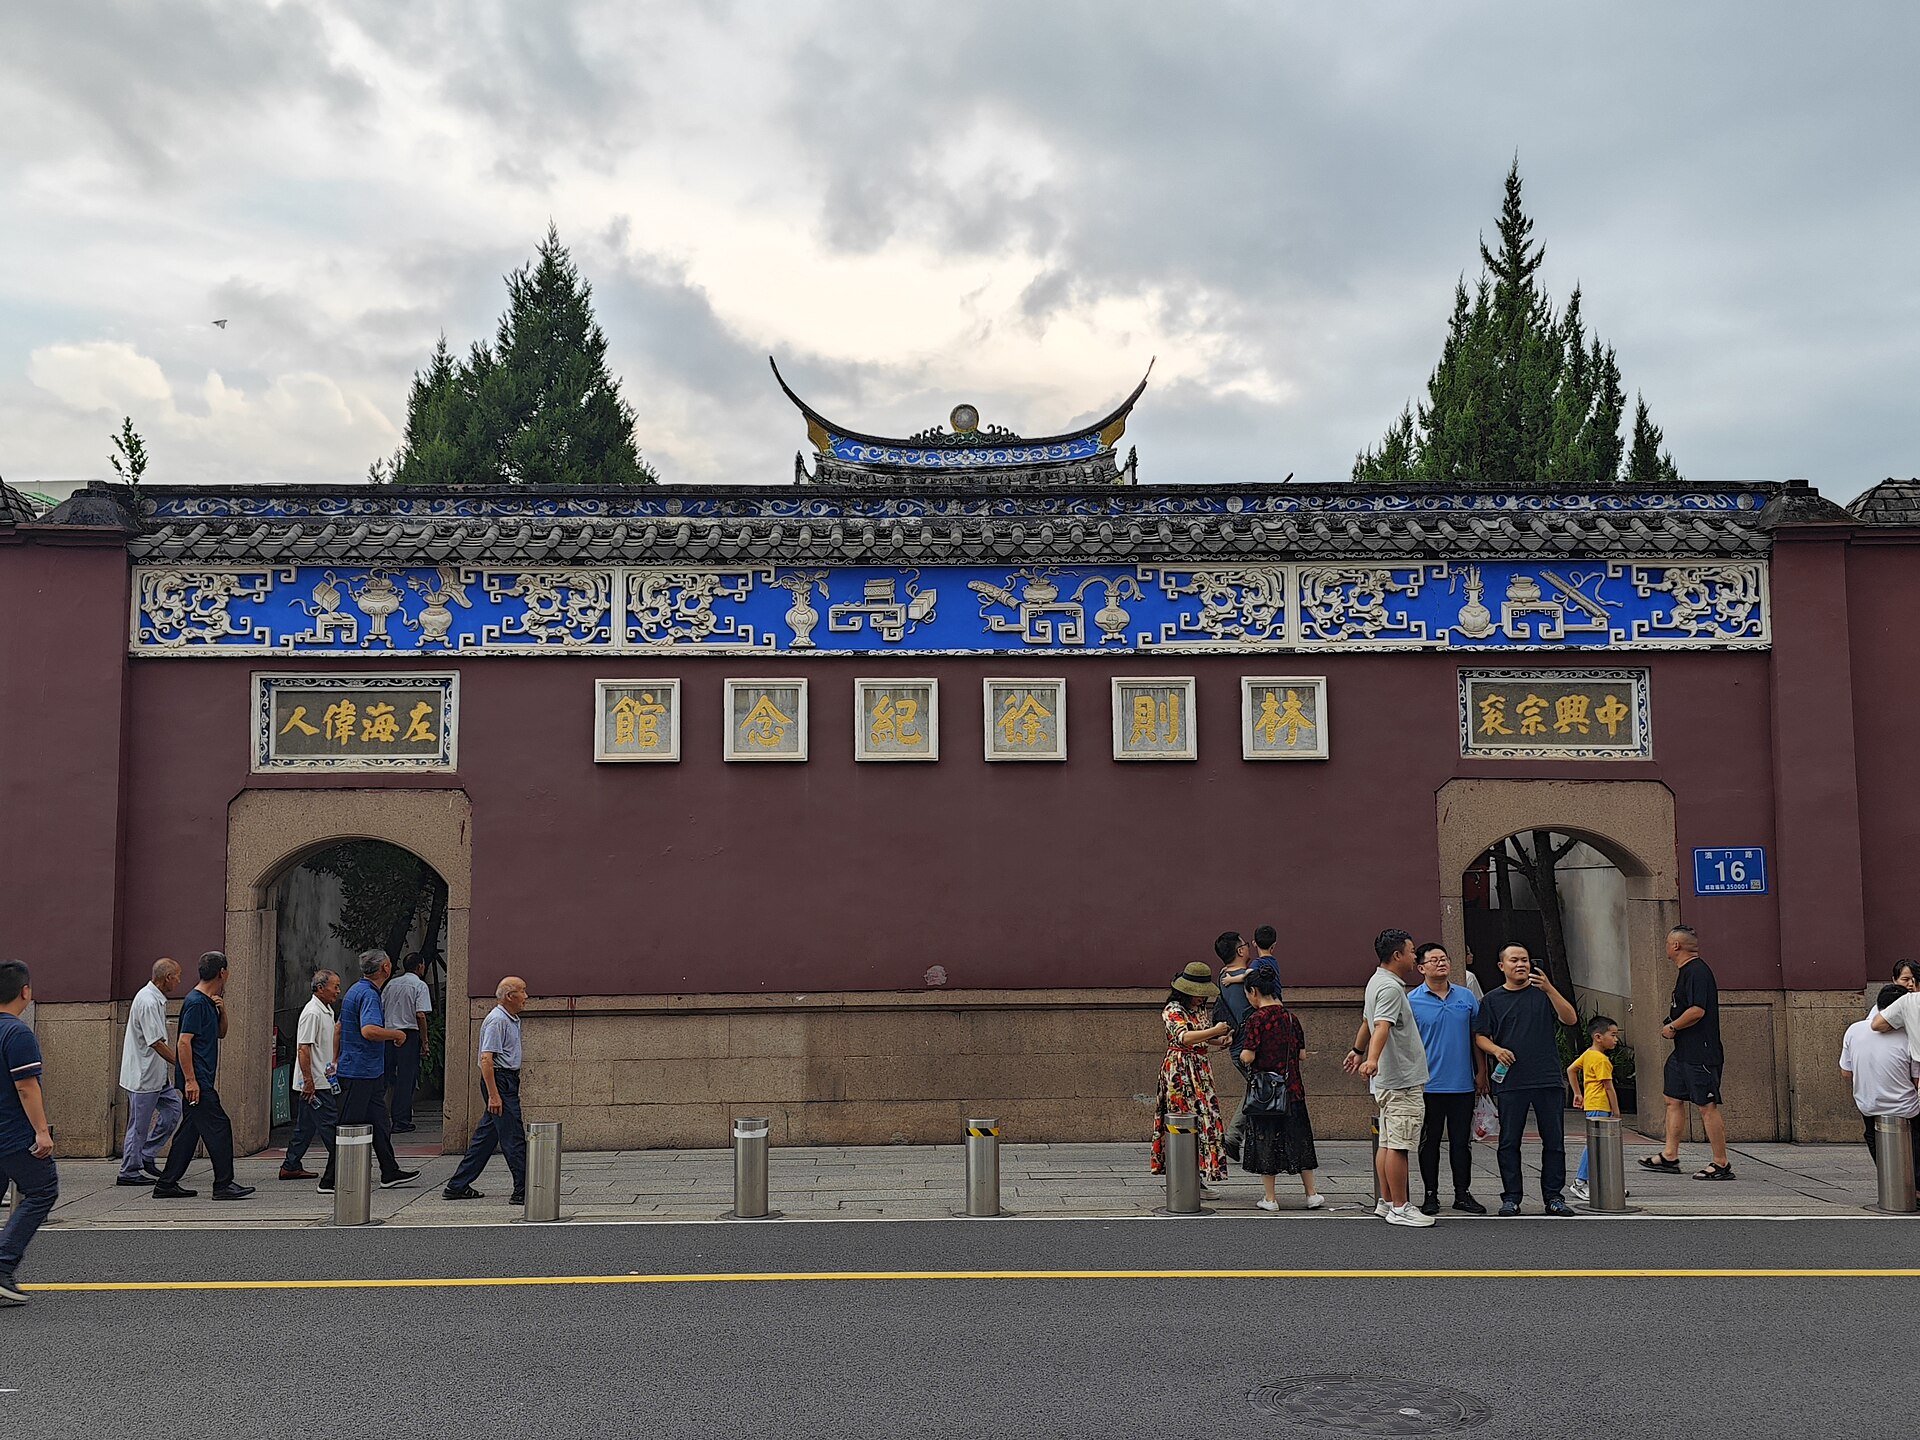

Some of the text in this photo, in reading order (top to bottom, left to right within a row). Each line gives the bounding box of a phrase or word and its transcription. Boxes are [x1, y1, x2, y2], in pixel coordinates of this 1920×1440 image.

[279, 698, 437, 746] 左海偉人
[1714, 860, 1746, 882] 16
